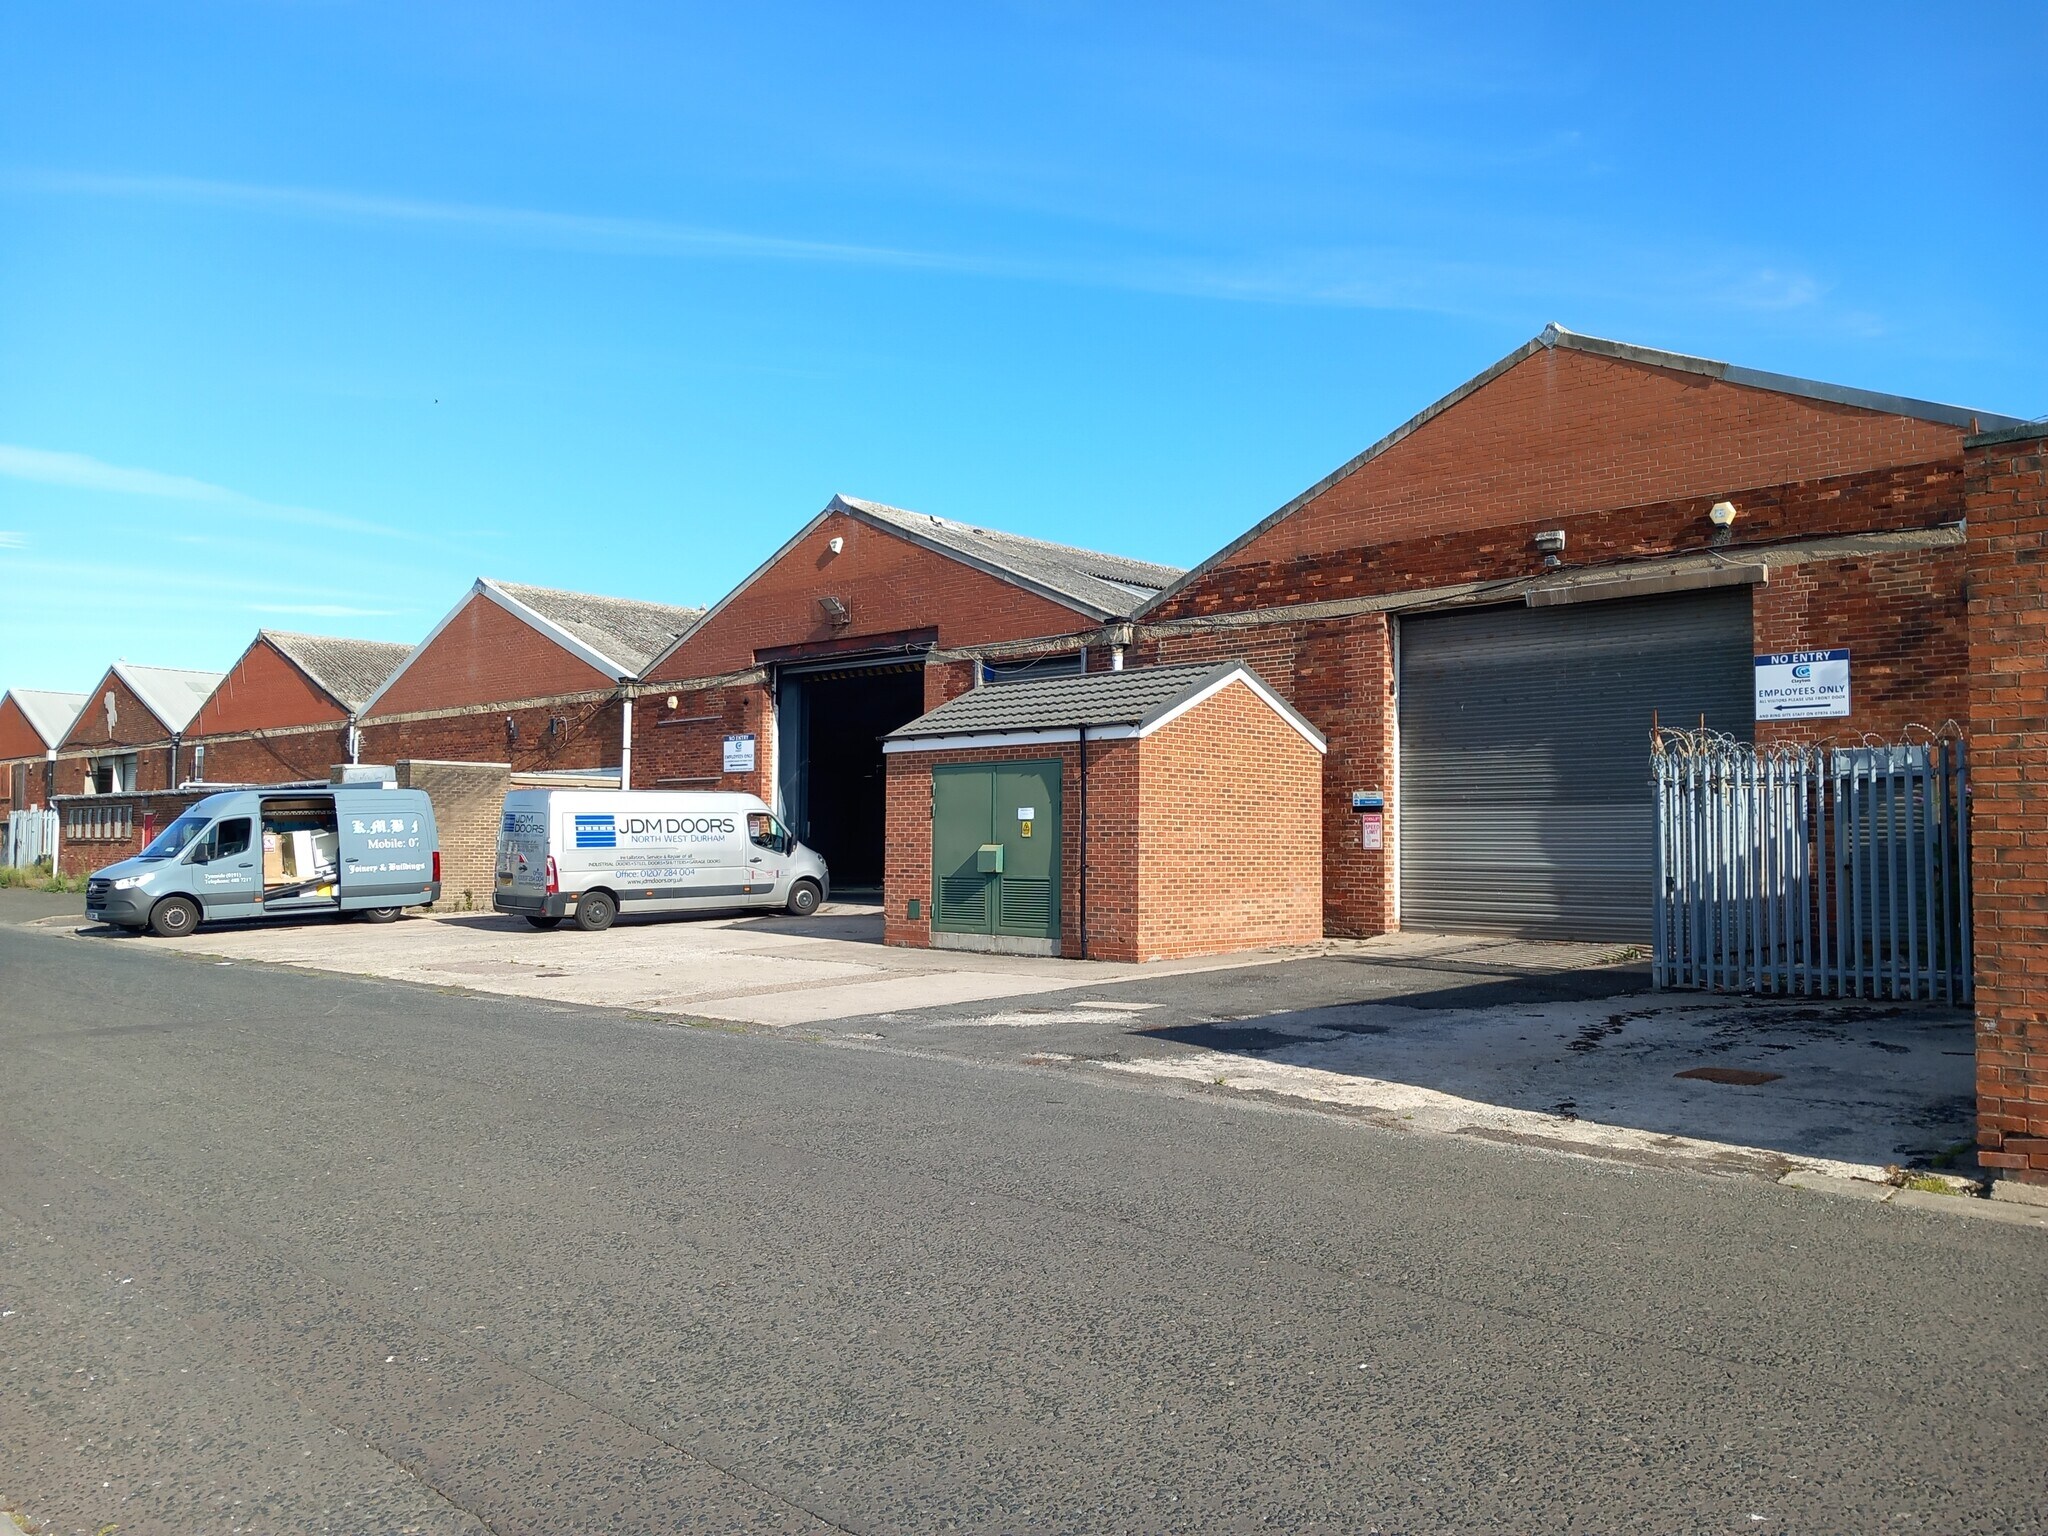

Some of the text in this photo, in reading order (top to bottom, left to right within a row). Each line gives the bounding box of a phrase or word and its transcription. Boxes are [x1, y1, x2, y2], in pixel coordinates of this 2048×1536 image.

[1771, 651, 1831, 664] NO ENTRY
[1759, 684, 1845, 697] EMPLOYEES ONLY
[515, 814, 534, 823] JDM
[514, 823, 545, 834] DOORS
[619, 818, 662, 834] JDM
[666, 818, 735, 834] DOORS
[367, 838, 406, 850] Mobile:
[631, 834, 726, 843] NORTH WEST DURHAM
[348, 862, 426, 875] Joinery & Buildings
[615, 868, 696, 879] Office: 01207 284 004
[627, 877, 684, 886] www.jdmdoors.org.uk
